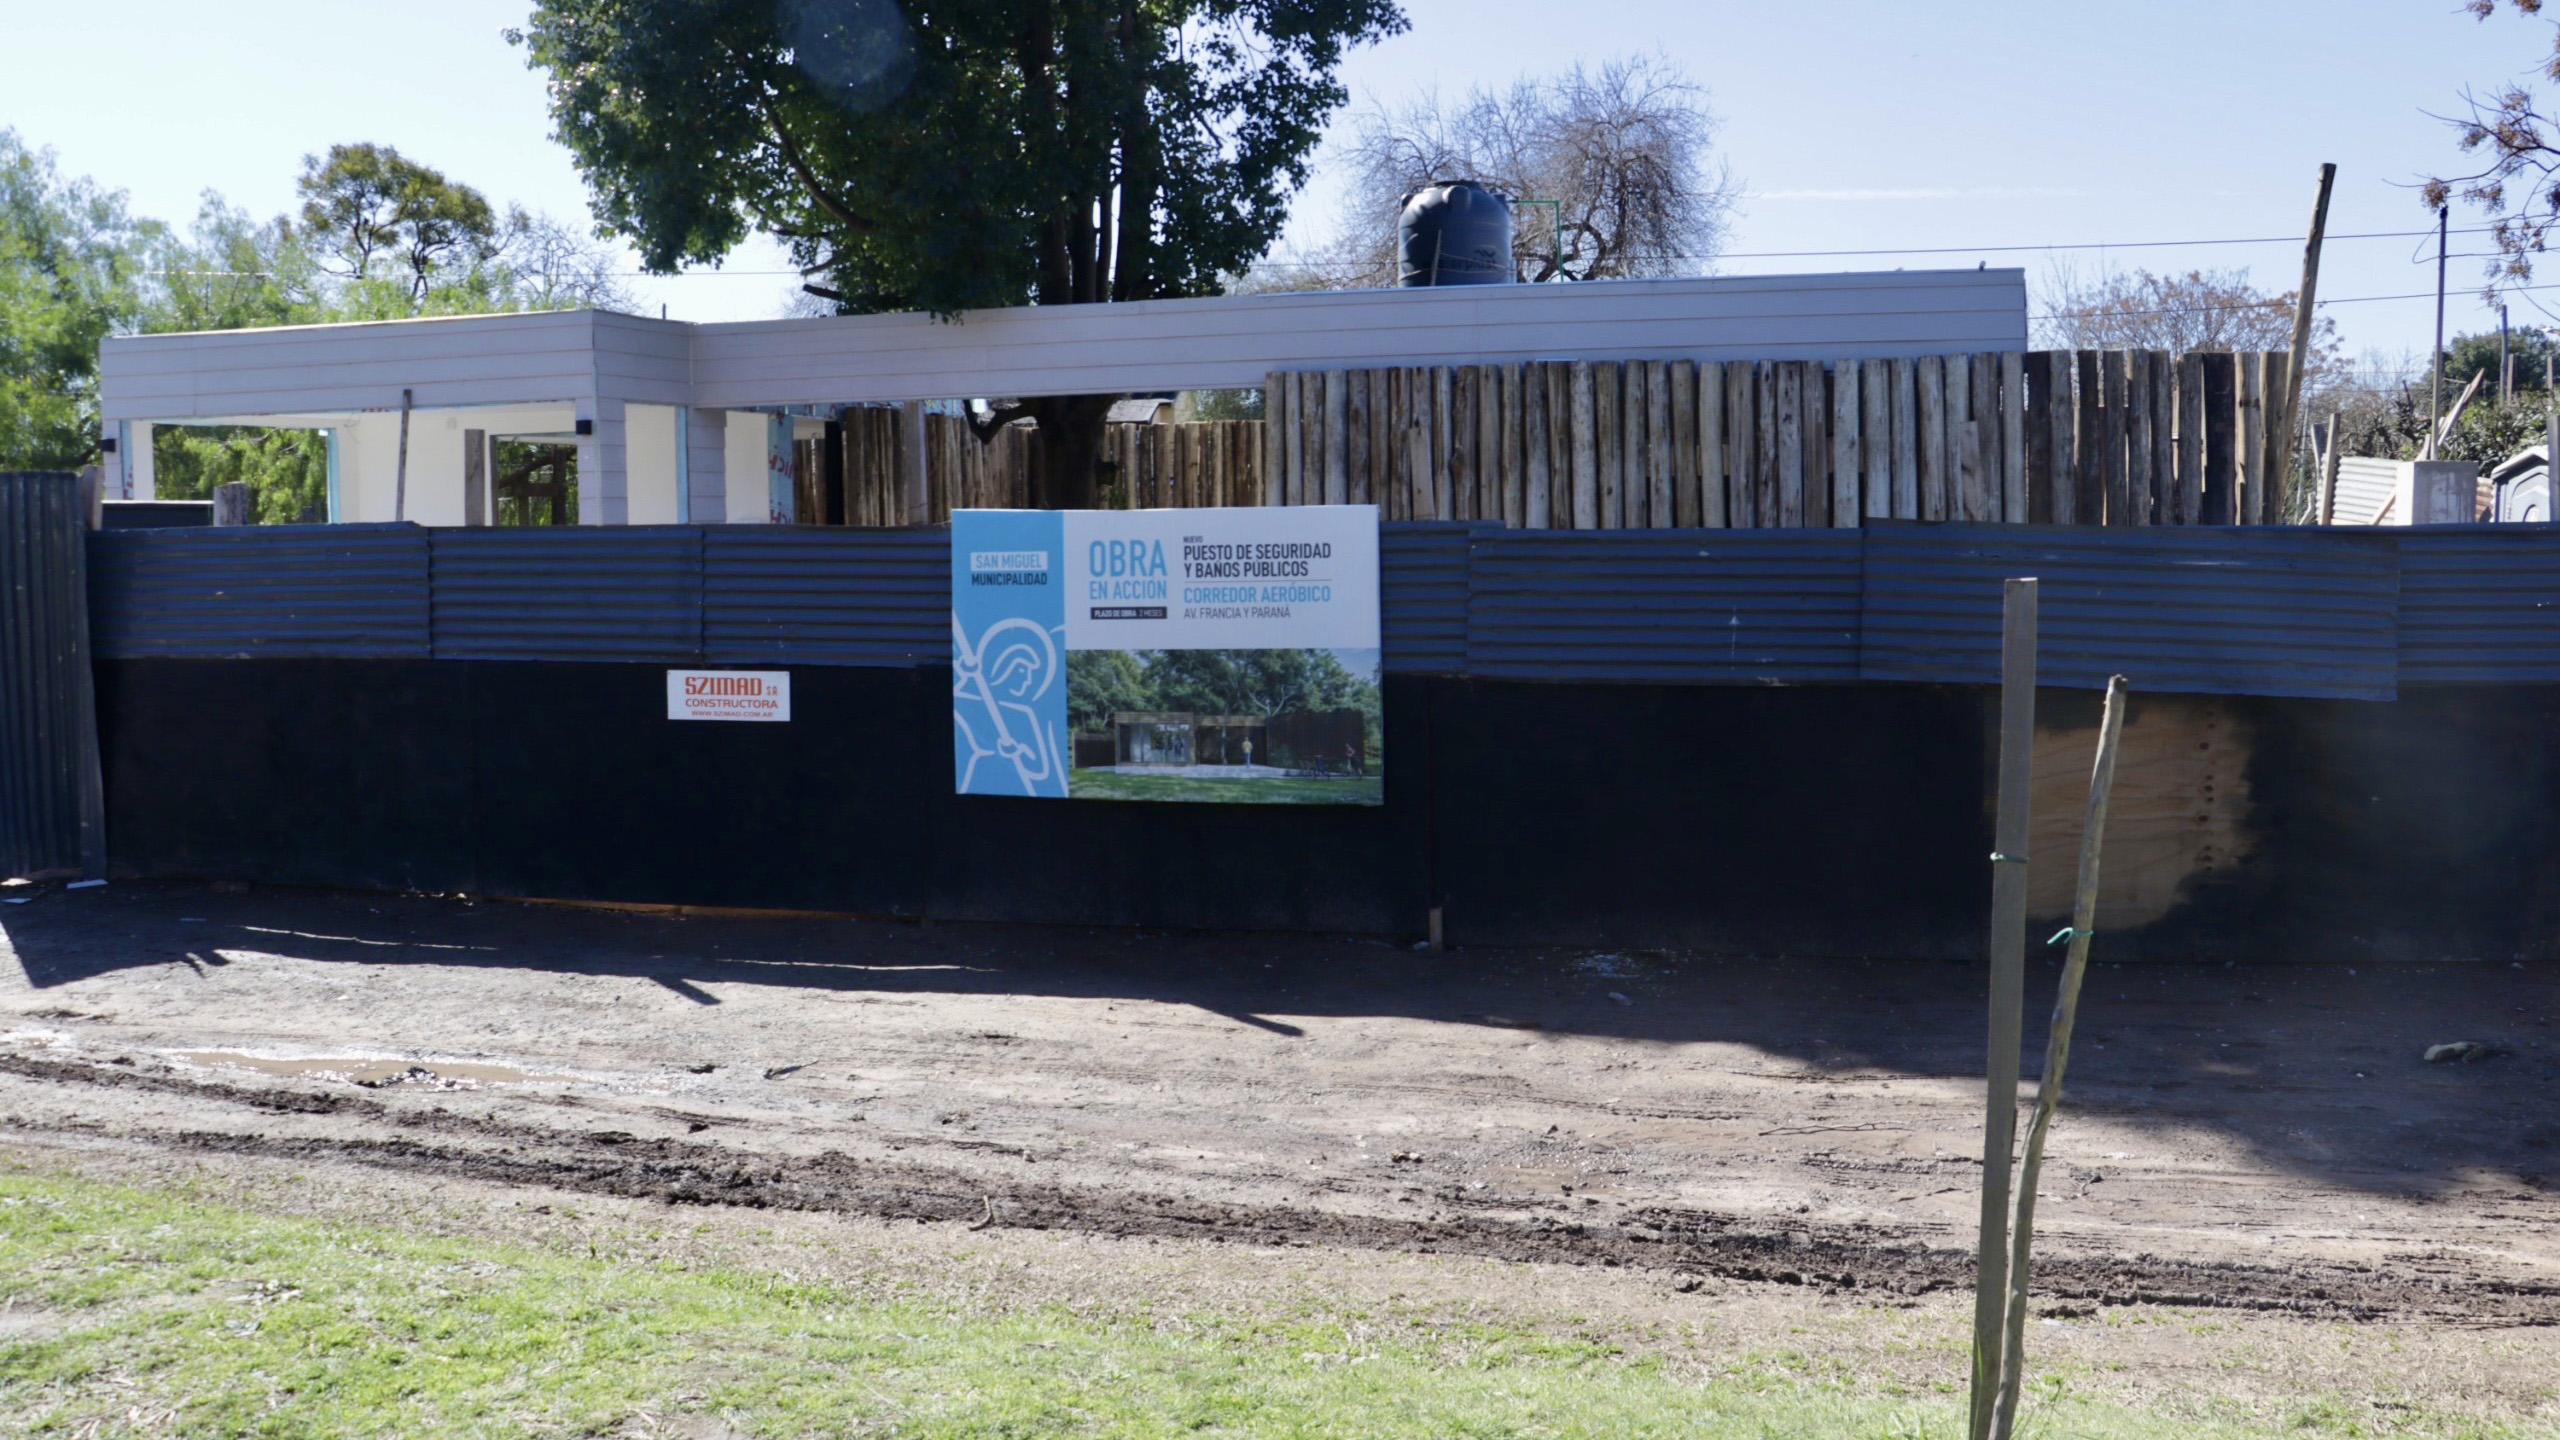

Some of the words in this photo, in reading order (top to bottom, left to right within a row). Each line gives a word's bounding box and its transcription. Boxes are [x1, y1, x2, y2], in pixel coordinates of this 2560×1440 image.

[1089, 539, 1168, 577] OBRA
[1184, 545, 1232, 560] PUESTO
[1236, 544, 1252, 560] DE
[1256, 543, 1331, 559] SEGURIDAD
[976, 554, 998, 569] SAN
[1001, 553, 1042, 568] MIGUEL
[1184, 563, 1192, 578] Y
[1195, 560, 1240, 577] BAÑOS
[1244, 559, 1308, 577] PÚBLICOS
[971, 573, 1048, 586] MUNICIPALIDAD
[1090, 581, 1108, 600] EN
[1184, 586, 1257, 603] CORREDOR
[1261, 582, 1331, 602] AERÓBICO
[1184, 607, 1197, 619] AV.
[1200, 607, 1241, 619] FRANCIA
[1244, 607, 1249, 618] Y
[685, 677, 762, 696] SZIMAD
[685, 699, 778, 709] CONSTRUCTORA
